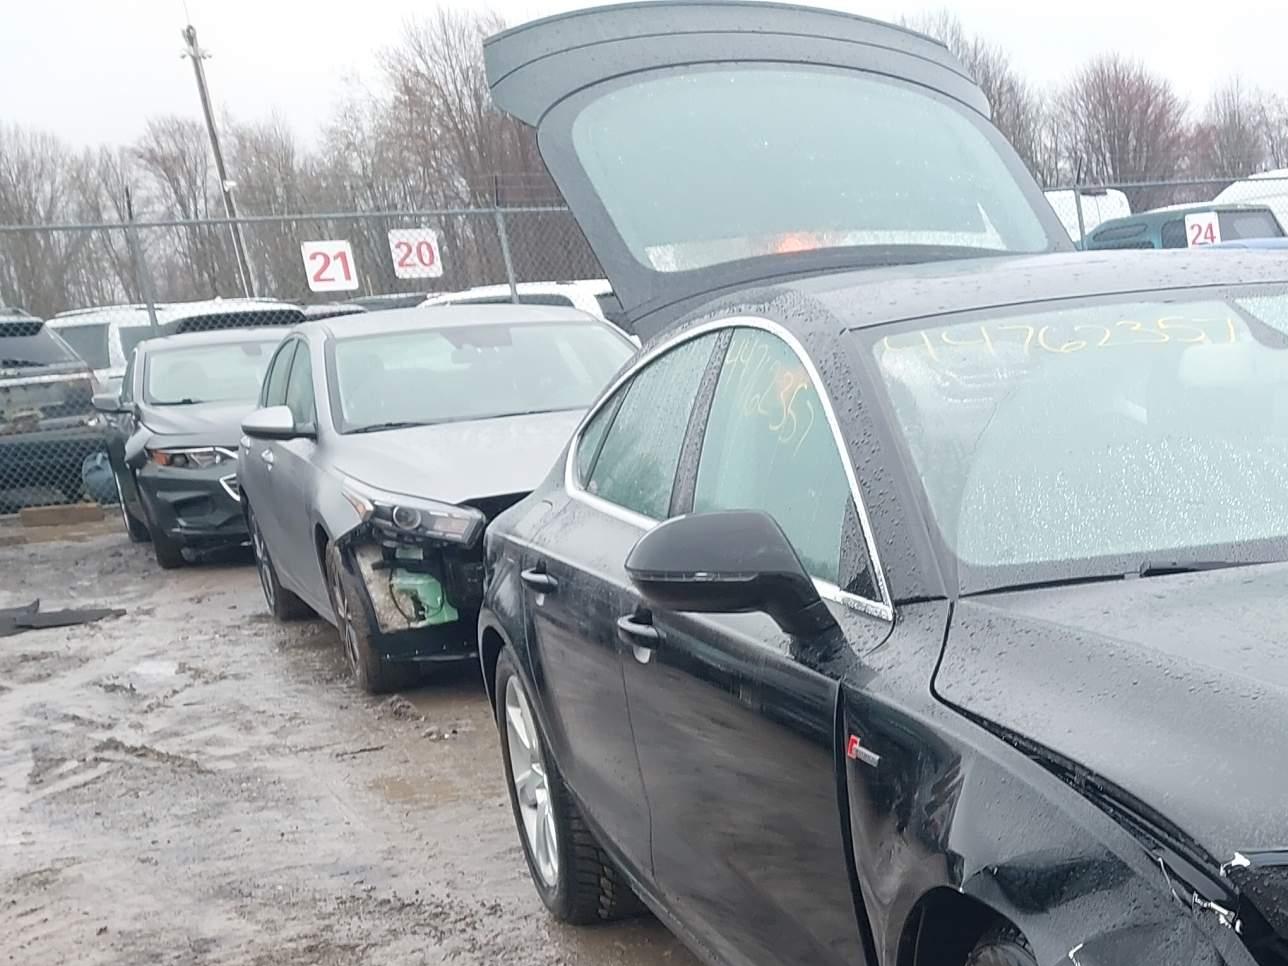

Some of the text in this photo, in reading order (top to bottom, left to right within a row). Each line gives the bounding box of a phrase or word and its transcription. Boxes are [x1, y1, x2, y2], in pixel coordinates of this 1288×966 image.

[1190, 223, 1217, 246] 24
[308, 251, 352, 283] 21
[394, 240, 435, 268] 20
